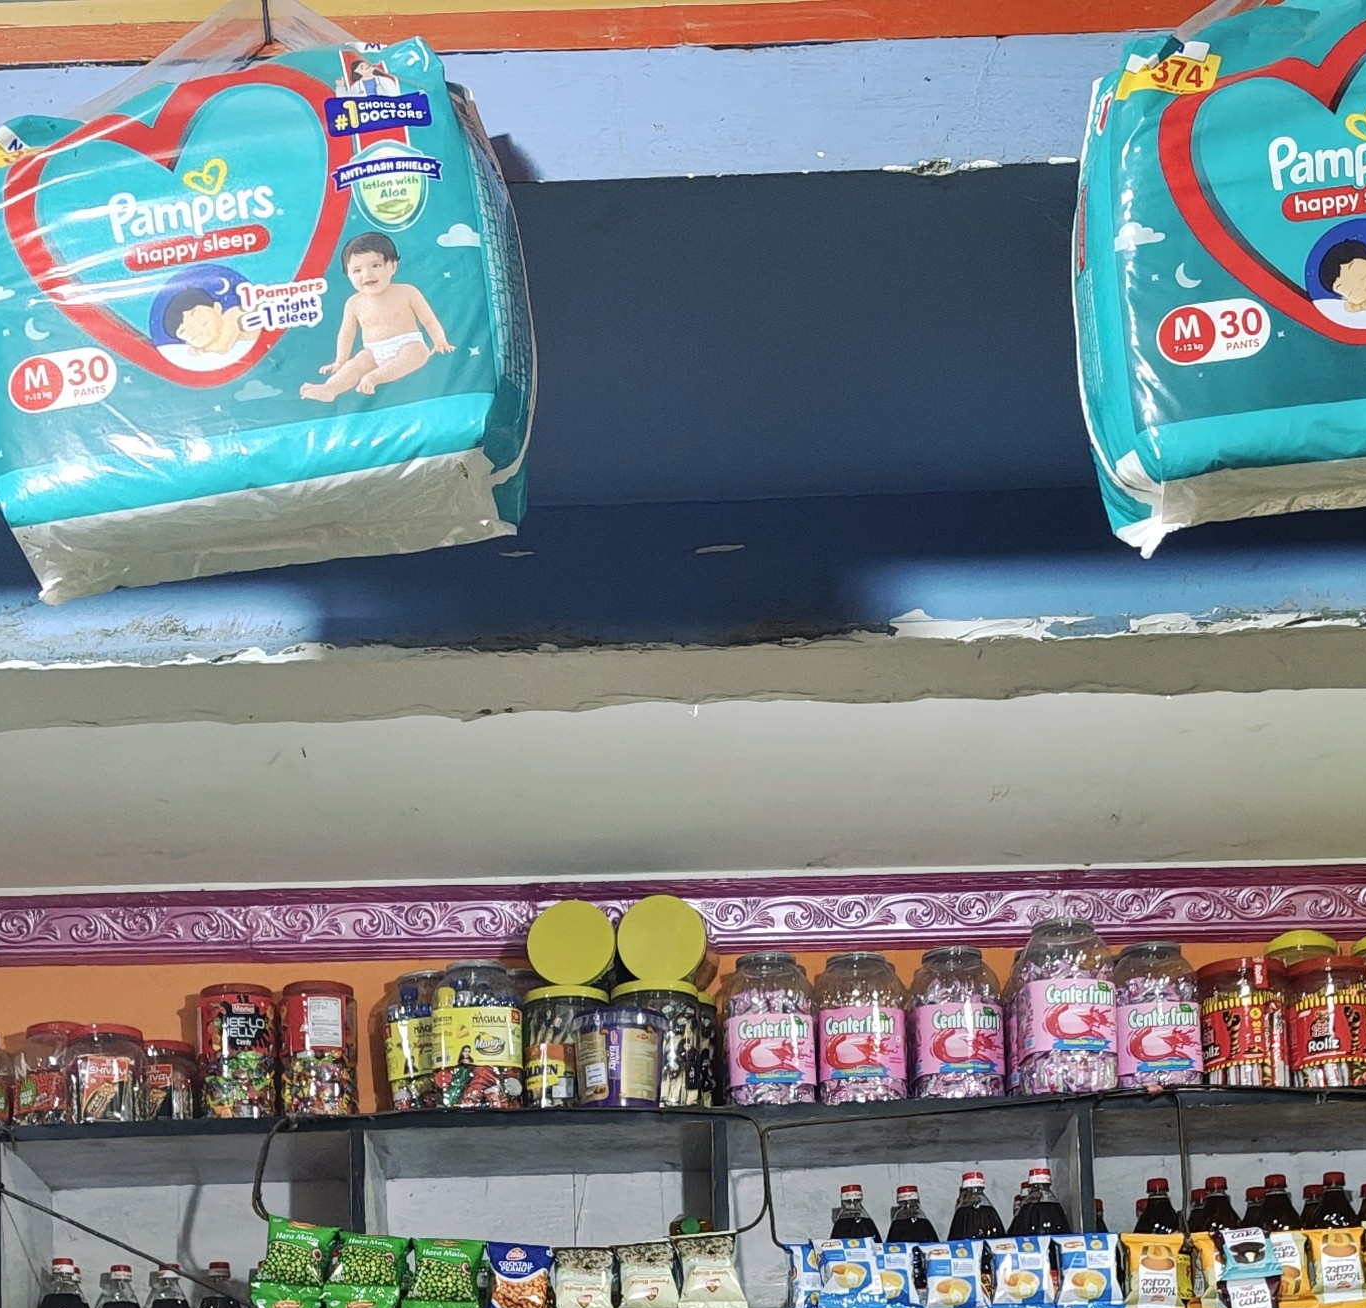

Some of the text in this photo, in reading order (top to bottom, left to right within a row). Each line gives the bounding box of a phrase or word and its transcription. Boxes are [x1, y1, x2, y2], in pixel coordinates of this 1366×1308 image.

[358, 101, 396, 110] CHOICE
[398, 102, 412, 110] OF
[360, 110, 423, 124] DOCTORS
[340, 161, 394, 182] ANTI-RASH
[362, 176, 419, 190] lotion with
[380, 187, 408, 199] Aloe
[1294, 193, 1359, 216] happy
[108, 186, 274, 243] Pampers
[136, 232, 257, 265] happy sleep
[256, 281, 323, 301] Pampers
[277, 297, 317, 314] night
[278, 309, 318, 325] sleep
[1174, 307, 1263, 342] M 30
[1226, 338, 1260, 351] PANTS
[24, 355, 109, 391] M 30
[74, 385, 107, 398] PANTS
[475, 1037, 504, 1050] Mango
[498, 1261, 534, 1270] COCKTAIL
[1239, 1294, 1269, 1306] cake
